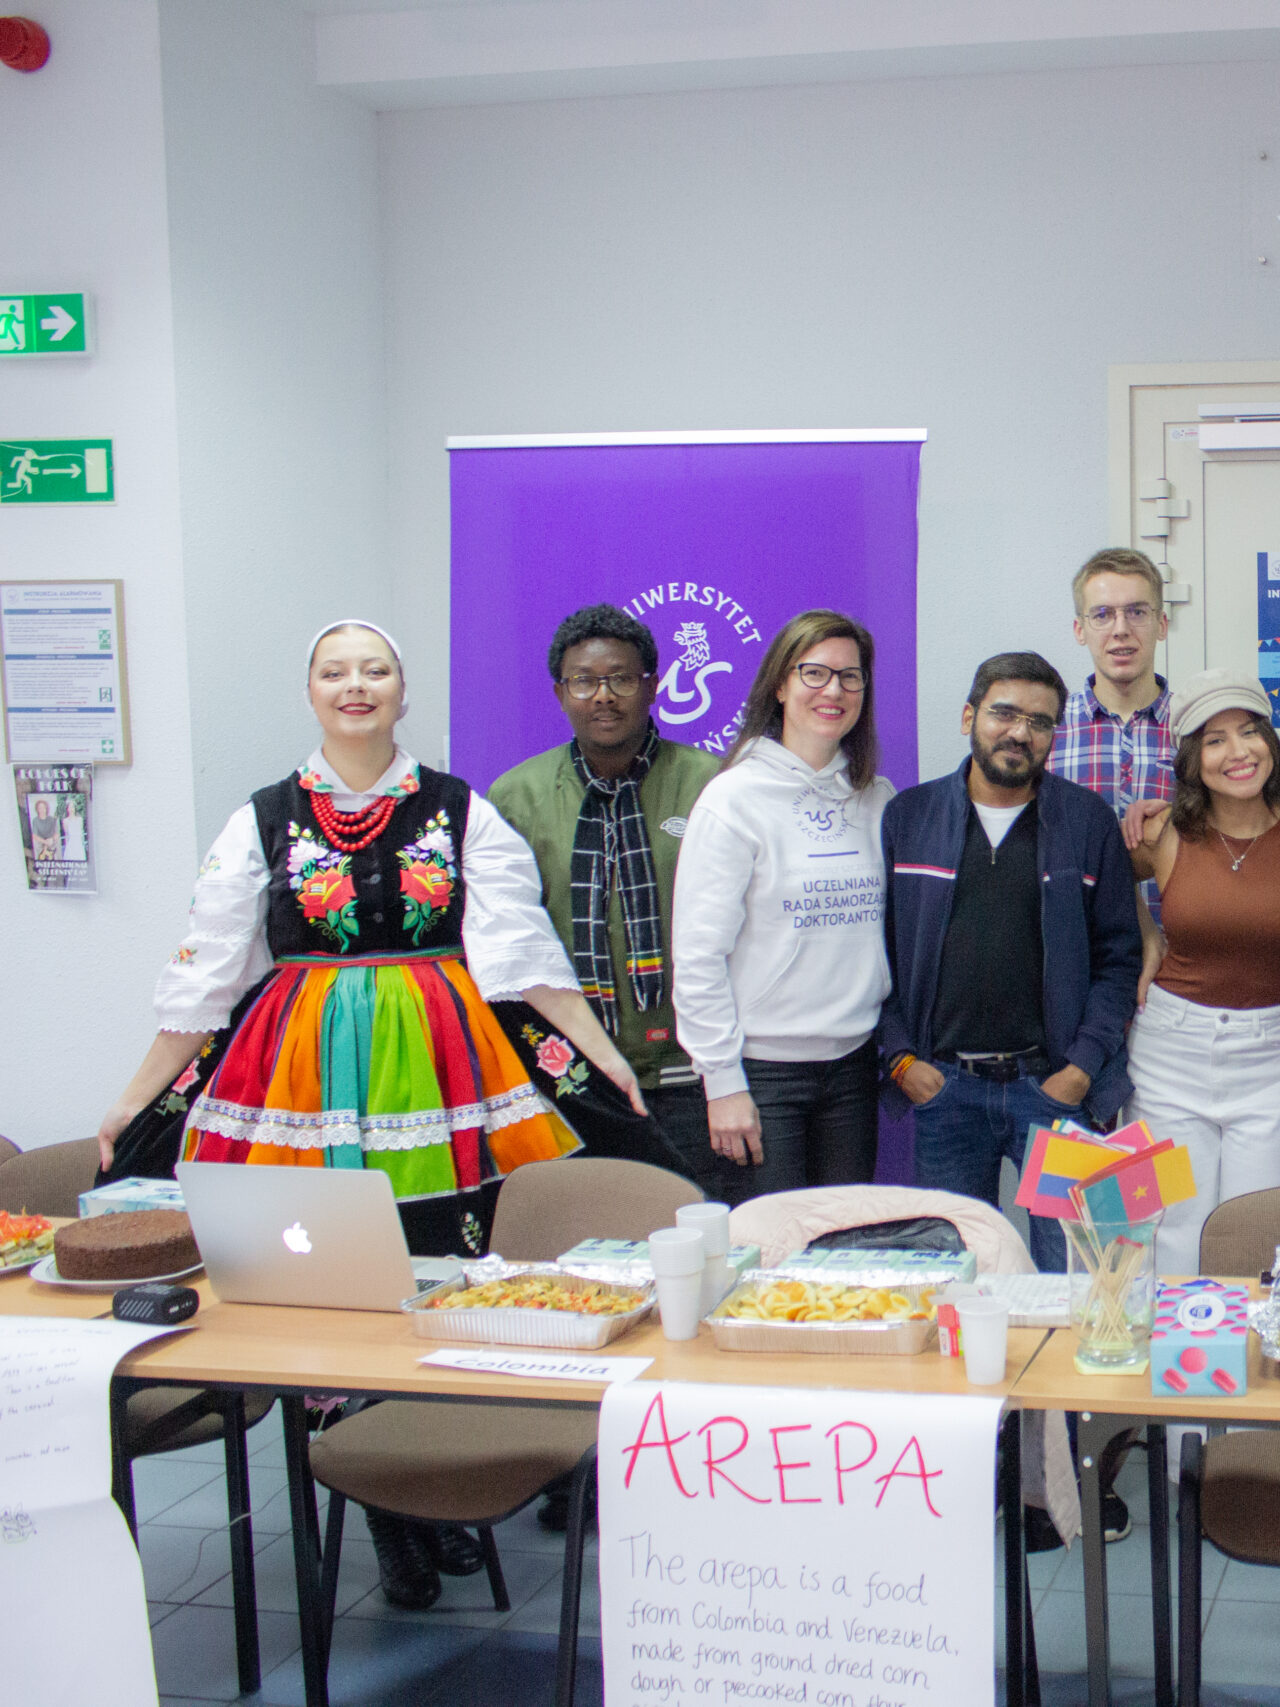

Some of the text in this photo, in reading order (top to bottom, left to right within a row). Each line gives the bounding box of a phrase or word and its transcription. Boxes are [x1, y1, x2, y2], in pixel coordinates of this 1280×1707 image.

[622, 582, 762, 644] IWERSYTET
[783, 898, 821, 912] RADA
[803, 876, 880, 893] UCZELNIANA
[456, 1358, 611, 1375] Colombia
[621, 1390, 944, 1518] AREPA
[618, 1530, 929, 1609] The arepa is a food
[626, 1599, 681, 1629] from
[691, 1601, 789, 1637] Colombia
[795, 1615, 833, 1641] and
[631, 1638, 931, 1691] made from ground dried corn
[630, 1670, 686, 1702] dough
[693, 1678, 715, 1695] or
[722, 1678, 808, 1704] precooked
[816, 1688, 855, 1707] corn
